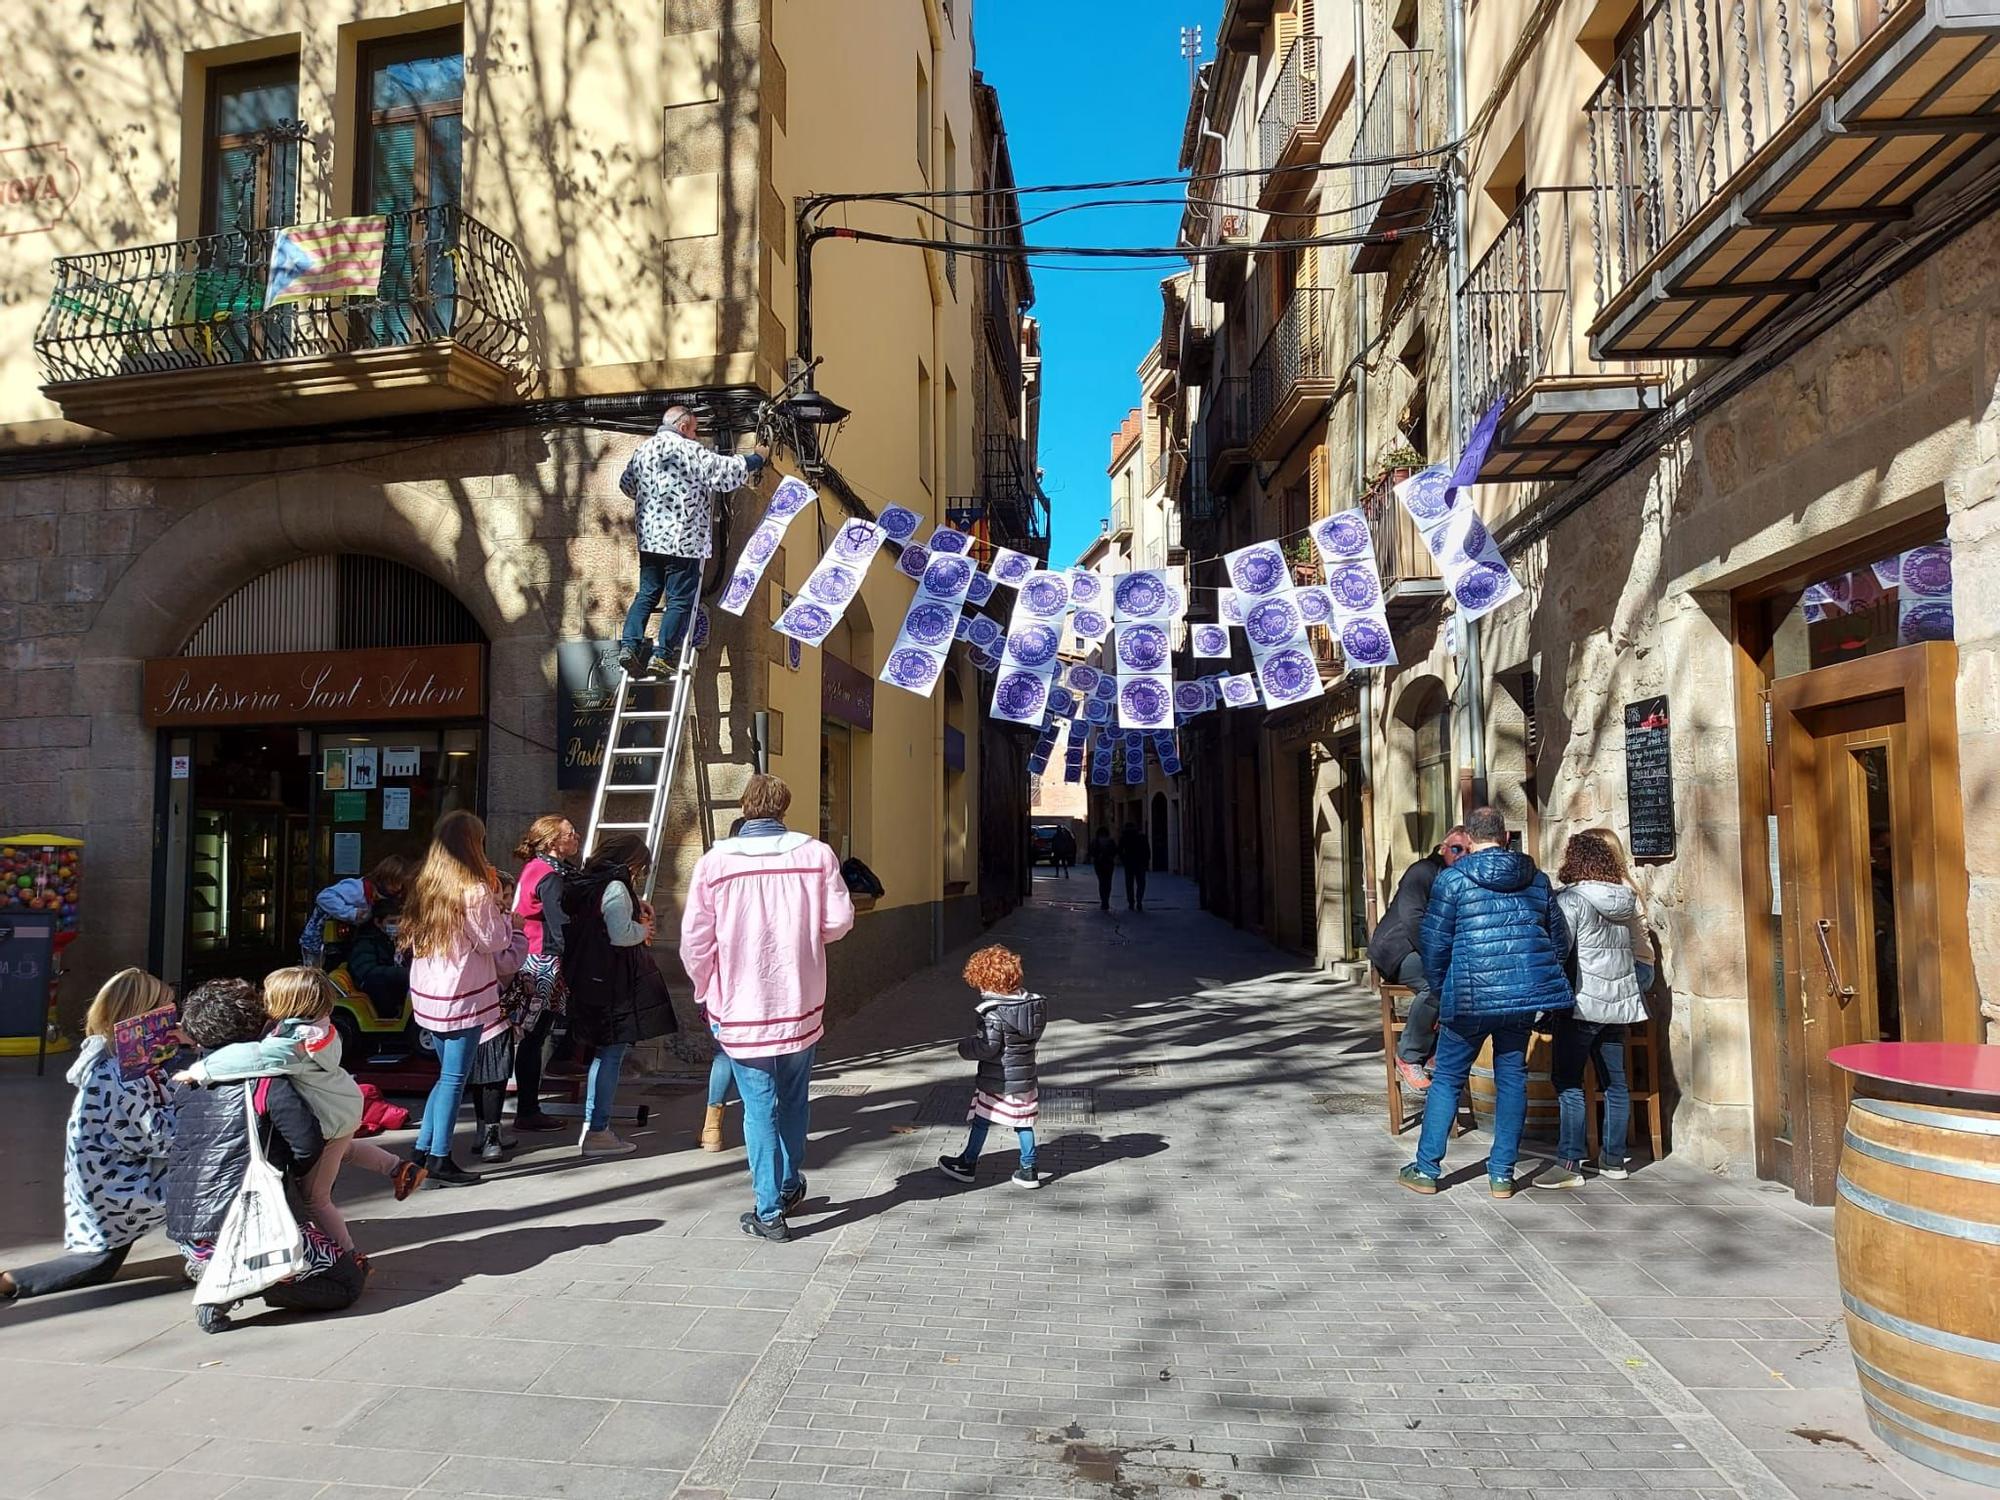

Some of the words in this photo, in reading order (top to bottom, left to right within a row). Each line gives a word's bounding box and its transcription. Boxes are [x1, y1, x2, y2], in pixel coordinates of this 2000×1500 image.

[1332, 518, 1357, 527] MUMS
[1238, 556, 1250, 568] VIP
[1248, 552, 1272, 561] MUMS
[947, 559, 966, 573] MUMS
[1467, 566, 1494, 576] MUMS
[1251, 561, 1279, 591] CARNAVAL
[1336, 569, 1349, 582] VIP
[1345, 567, 1370, 580] MUMS
[1461, 573, 1472, 586] VIP
[1030, 579, 1043, 587] VIP
[1043, 578, 1063, 591] MUMS
[1123, 579, 1135, 590] VIP
[1134, 576, 1156, 588] MUMS
[1478, 571, 1506, 605] CARNAVAL
[1130, 590, 1161, 612] CARNAVAL
[918, 607, 931, 616] VIP
[931, 607, 949, 622] MUMS
[1253, 606, 1265, 619] VIP
[1263, 603, 1287, 613] MUMS
[1032, 626, 1052, 640] MUMS
[1265, 613, 1294, 641] CARNAVAL
[1357, 621, 1381, 633] MUMS
[1125, 629, 1138, 641] VIP
[1137, 628, 1160, 640] MUMS
[901, 650, 914, 658] VIP
[914, 651, 933, 666] MUMS
[1132, 642, 1163, 666] CARNAVAL
[1278, 654, 1304, 665] MUMS
[1268, 658, 1281, 672] VIP
[155, 668, 281, 716] Pastisseria
[292, 664, 363, 711] Sant
[370, 658, 469, 709] Antoni
[1006, 676, 1019, 686] VIP
[1019, 675, 1039, 691] MUMS
[1280, 665, 1310, 696] CARNAVAL
[1128, 682, 1141, 695] VIP
[1140, 682, 1162, 695] MUMS
[1005, 694, 1041, 714] CARNAVAL
[1134, 698, 1165, 719] CARNAVAL
